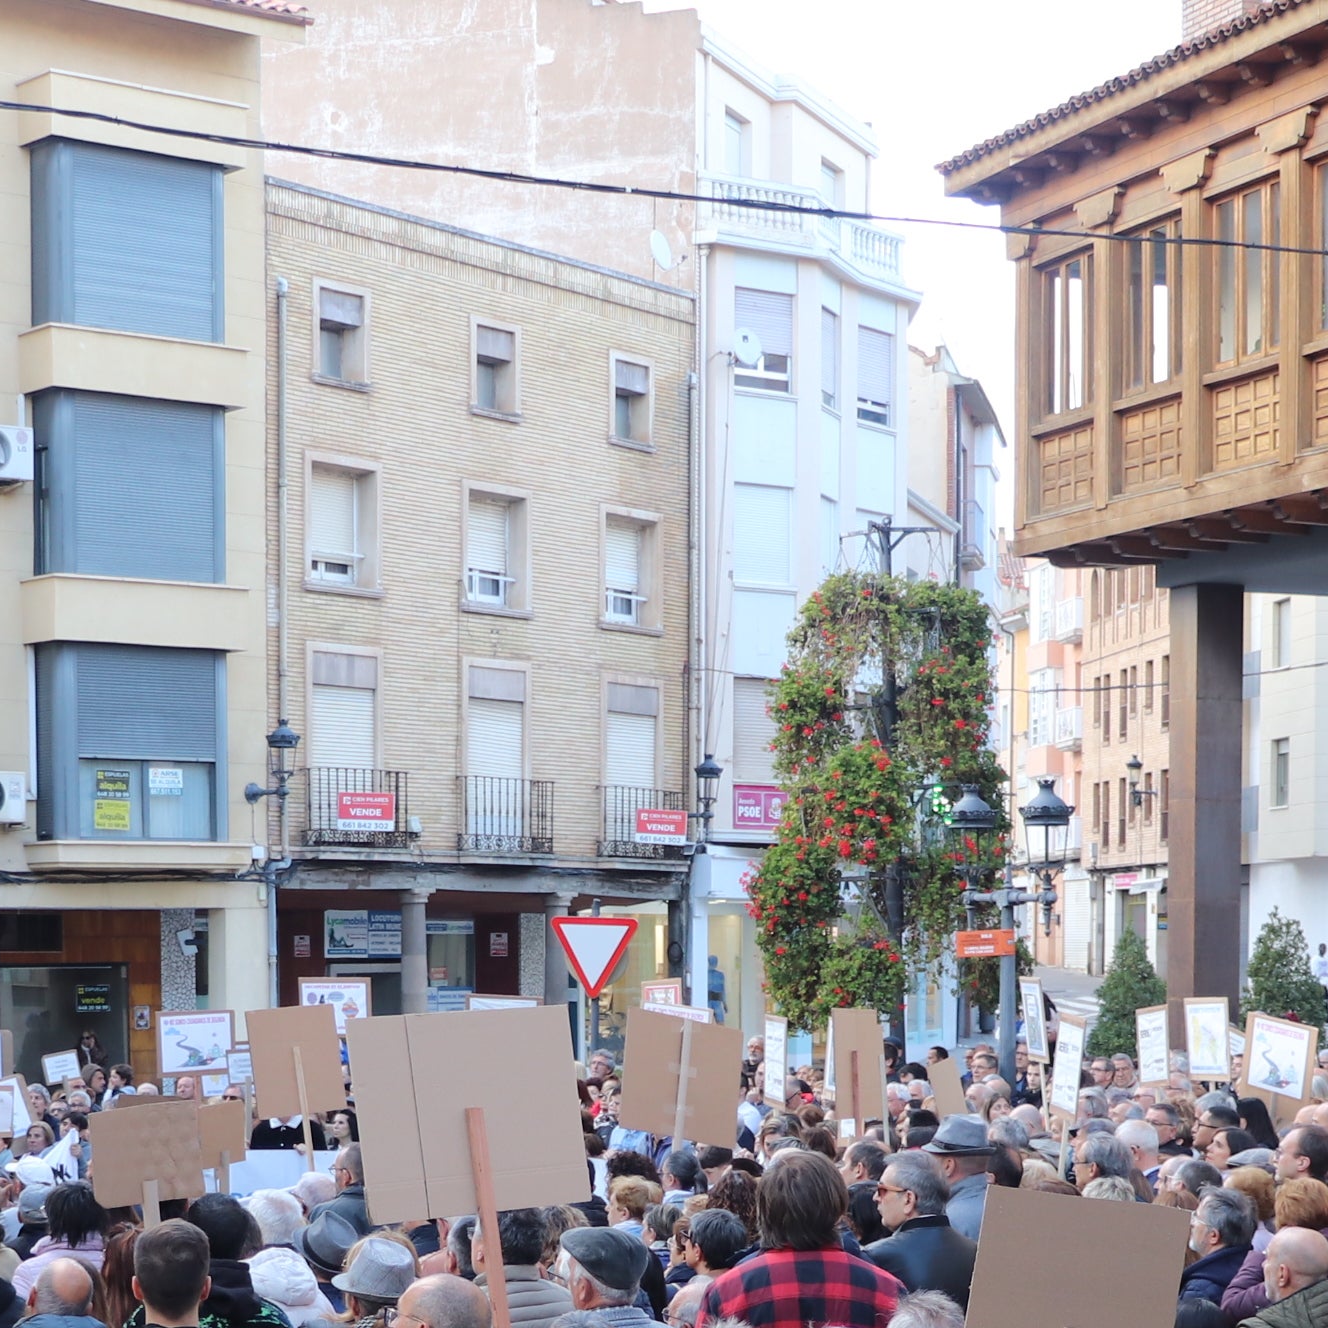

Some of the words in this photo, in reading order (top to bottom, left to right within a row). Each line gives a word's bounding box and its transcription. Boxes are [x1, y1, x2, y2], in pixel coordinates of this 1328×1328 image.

[99, 780, 127, 791] alquila
[99, 812, 127, 822] alquila
[349, 807, 383, 817] VENDE
[737, 806, 762, 818] PSOE
[342, 821, 356, 829] 661
[374, 822, 389, 830] 302
[646, 822, 676, 832] VENDE
[639, 835, 652, 843] 661
[653, 835, 666, 843] 842
[668, 836, 682, 844] 302
[327, 915, 367, 928] Lycamobile
[81, 996, 106, 1005] vende
